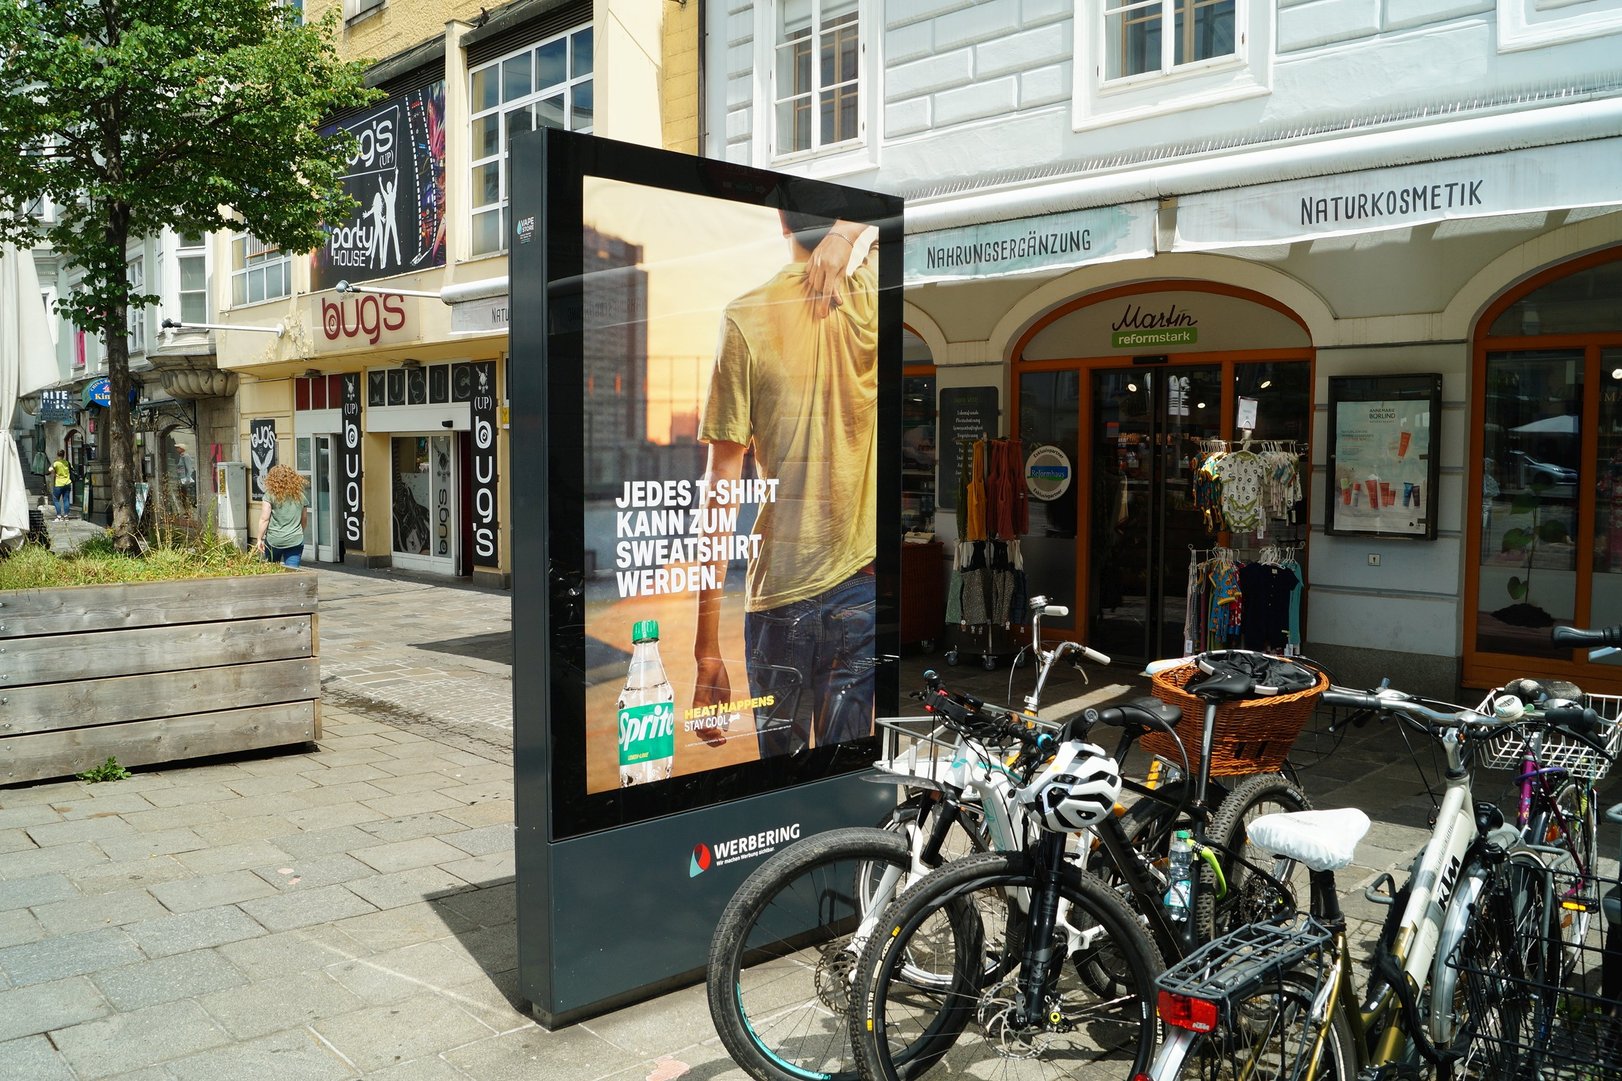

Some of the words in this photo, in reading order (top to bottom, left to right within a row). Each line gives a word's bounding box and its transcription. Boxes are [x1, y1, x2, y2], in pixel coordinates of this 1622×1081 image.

[379, 150, 395, 169] (UP)
[1301, 179, 1484, 226] NATURKOSMETIK
[331, 218, 374, 257] party
[927, 229, 1091, 269] NAHRUNGSERGÄNZUNG
[333, 250, 367, 268] HOUSE
[1112, 303, 1198, 331] Martin
[1118, 331, 1191, 345] reformstark
[344, 403, 358, 416] (UP)
[474, 395, 493, 412] (UP)
[344, 420, 360, 541] bug's
[473, 416, 494, 557] bug's
[1031, 469, 1066, 478] Reformhaus
[615, 479, 692, 509] JEDES
[695, 478, 780, 506] T-SHIRT
[616, 509, 685, 538] KANN
[689, 508, 737, 534] ZUM
[616, 534, 762, 568] SWEATSHIRT
[616, 565, 722, 598] WERDEN.
[684, 704, 718, 720] HEAT
[719, 695, 775, 713] HAPPENS
[618, 704, 674, 752] Sprite
[684, 718, 705, 732] STAY
[706, 714, 729, 729] COOL
[713, 823, 800, 860] WERBERING
[740, 851, 759, 860] Werbung
[1437, 854, 1461, 913] KTM
[868, 992, 875, 1001] TR
